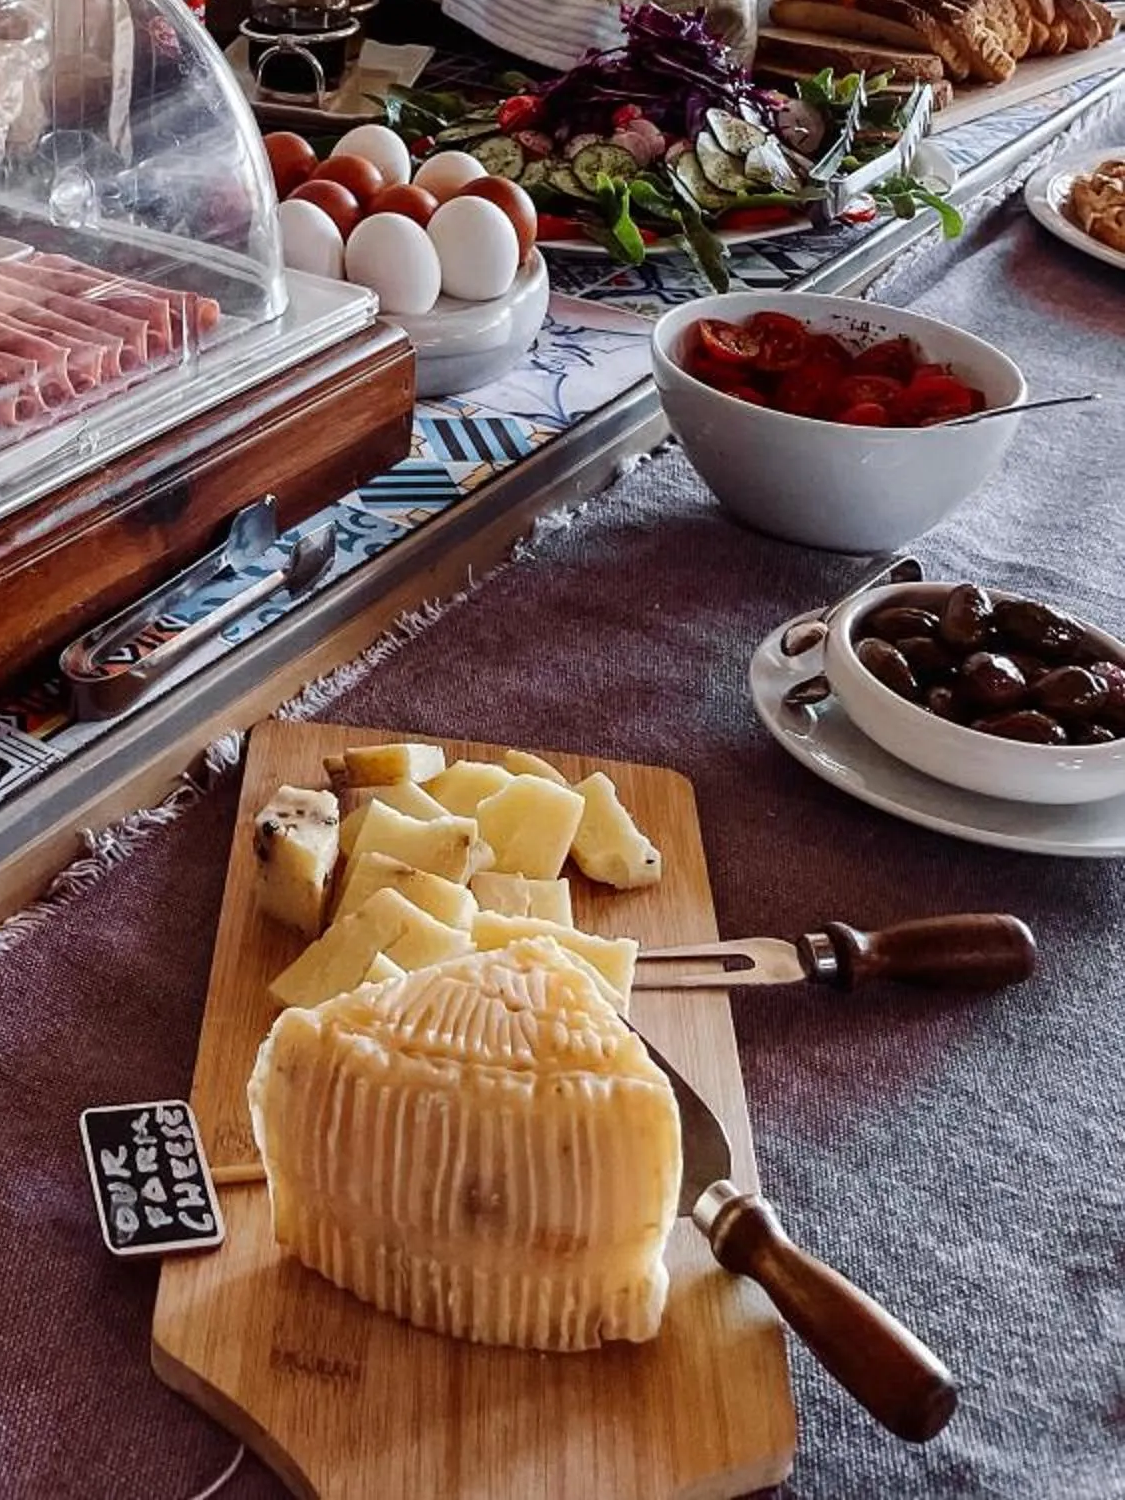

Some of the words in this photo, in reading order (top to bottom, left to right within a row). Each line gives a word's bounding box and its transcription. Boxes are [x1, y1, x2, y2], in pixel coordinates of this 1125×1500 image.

[100, 1145, 140, 1237] OUR
[131, 1111, 174, 1229] FARM
[156, 1104, 215, 1232] CHEESE
